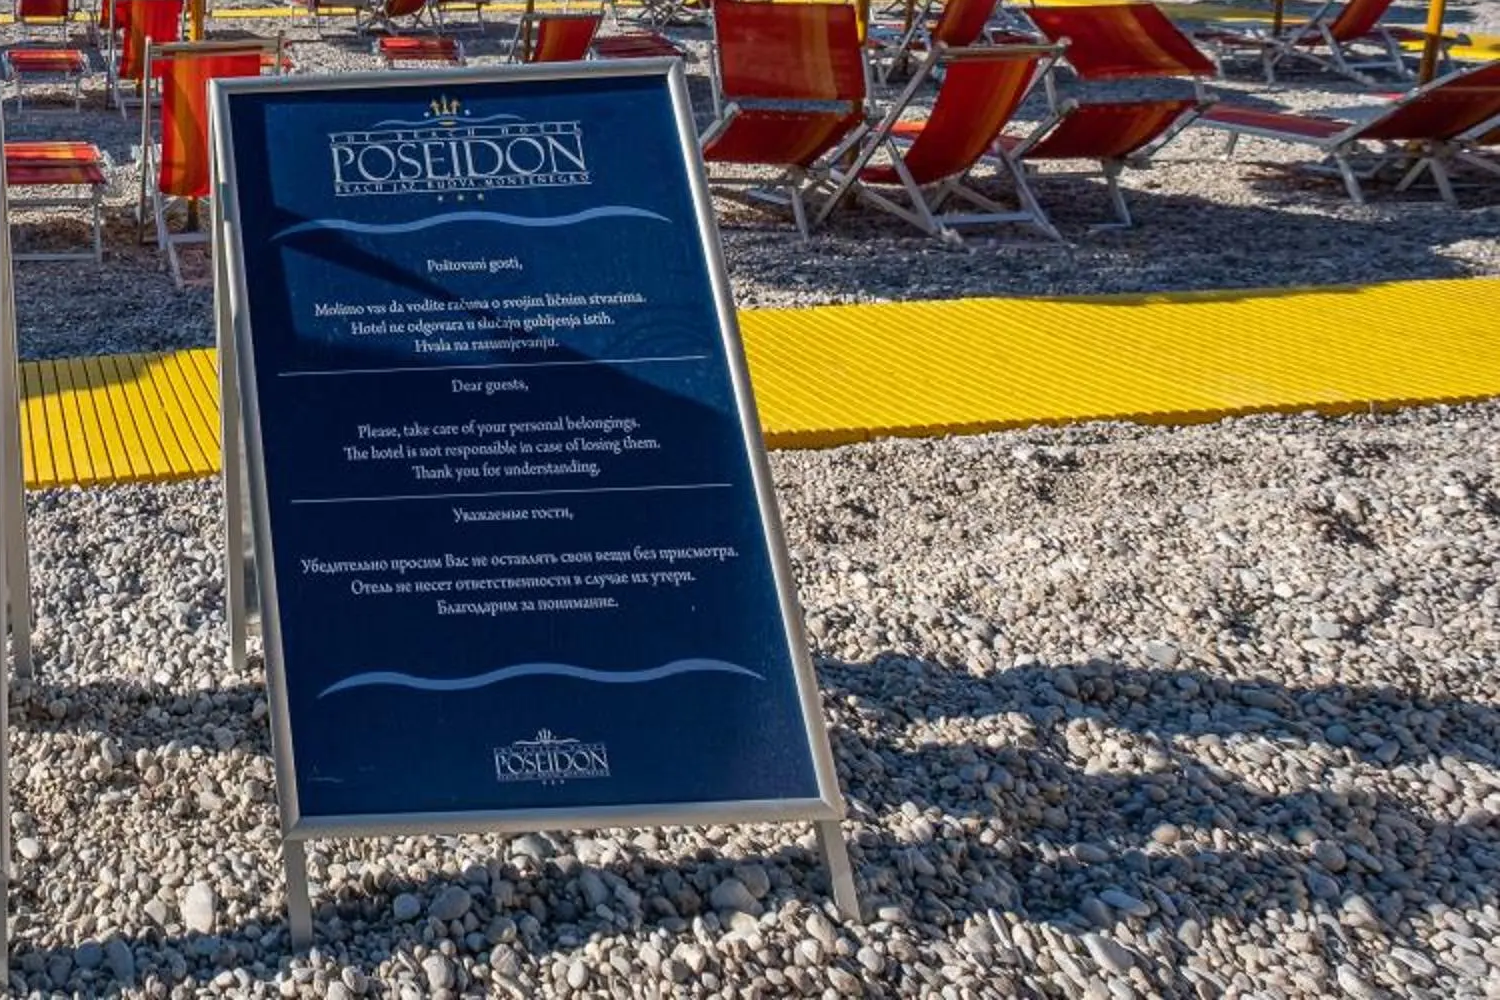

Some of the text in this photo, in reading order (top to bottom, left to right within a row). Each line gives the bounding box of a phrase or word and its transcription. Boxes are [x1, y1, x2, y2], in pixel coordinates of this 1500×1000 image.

[330, 136, 587, 183] POSEIDON
[315, 302, 364, 317] Molimo
[366, 304, 386, 314] vas
[389, 300, 404, 313] da
[406, 298, 445, 312] vodite
[503, 296, 545, 311] svojim
[351, 320, 387, 335] Hotel
[390, 324, 405, 333] ne
[407, 318, 464, 336] odgovara
[415, 338, 452, 352] Hvala
[452, 378, 482, 392] Dear
[403, 421, 430, 437] take
[432, 425, 459, 435] care
[461, 419, 474, 434] of
[476, 423, 506, 437] your
[509, 416, 564, 437] personal
[344, 446, 369, 461] The
[371, 444, 404, 459] hotel
[406, 446, 417, 458] is
[420, 446, 442, 457] not
[445, 440, 517, 460] responsible
[520, 441, 533, 453] in
[535, 443, 562, 453] case
[566, 438, 578, 452] of
[582, 438, 622, 455] losing
[412, 464, 454, 480] Thank
[453, 467, 480, 482] you
[482, 462, 501, 477] for
[531, 507, 574, 520] гости,
[445, 553, 469, 568] Вас
[595, 551, 631, 562] вещи
[633, 545, 657, 560] без
[351, 580, 393, 595] Отель
[414, 581, 452, 592] несет
[584, 574, 628, 588] случае
[495, 748, 609, 775] POSEIDON
